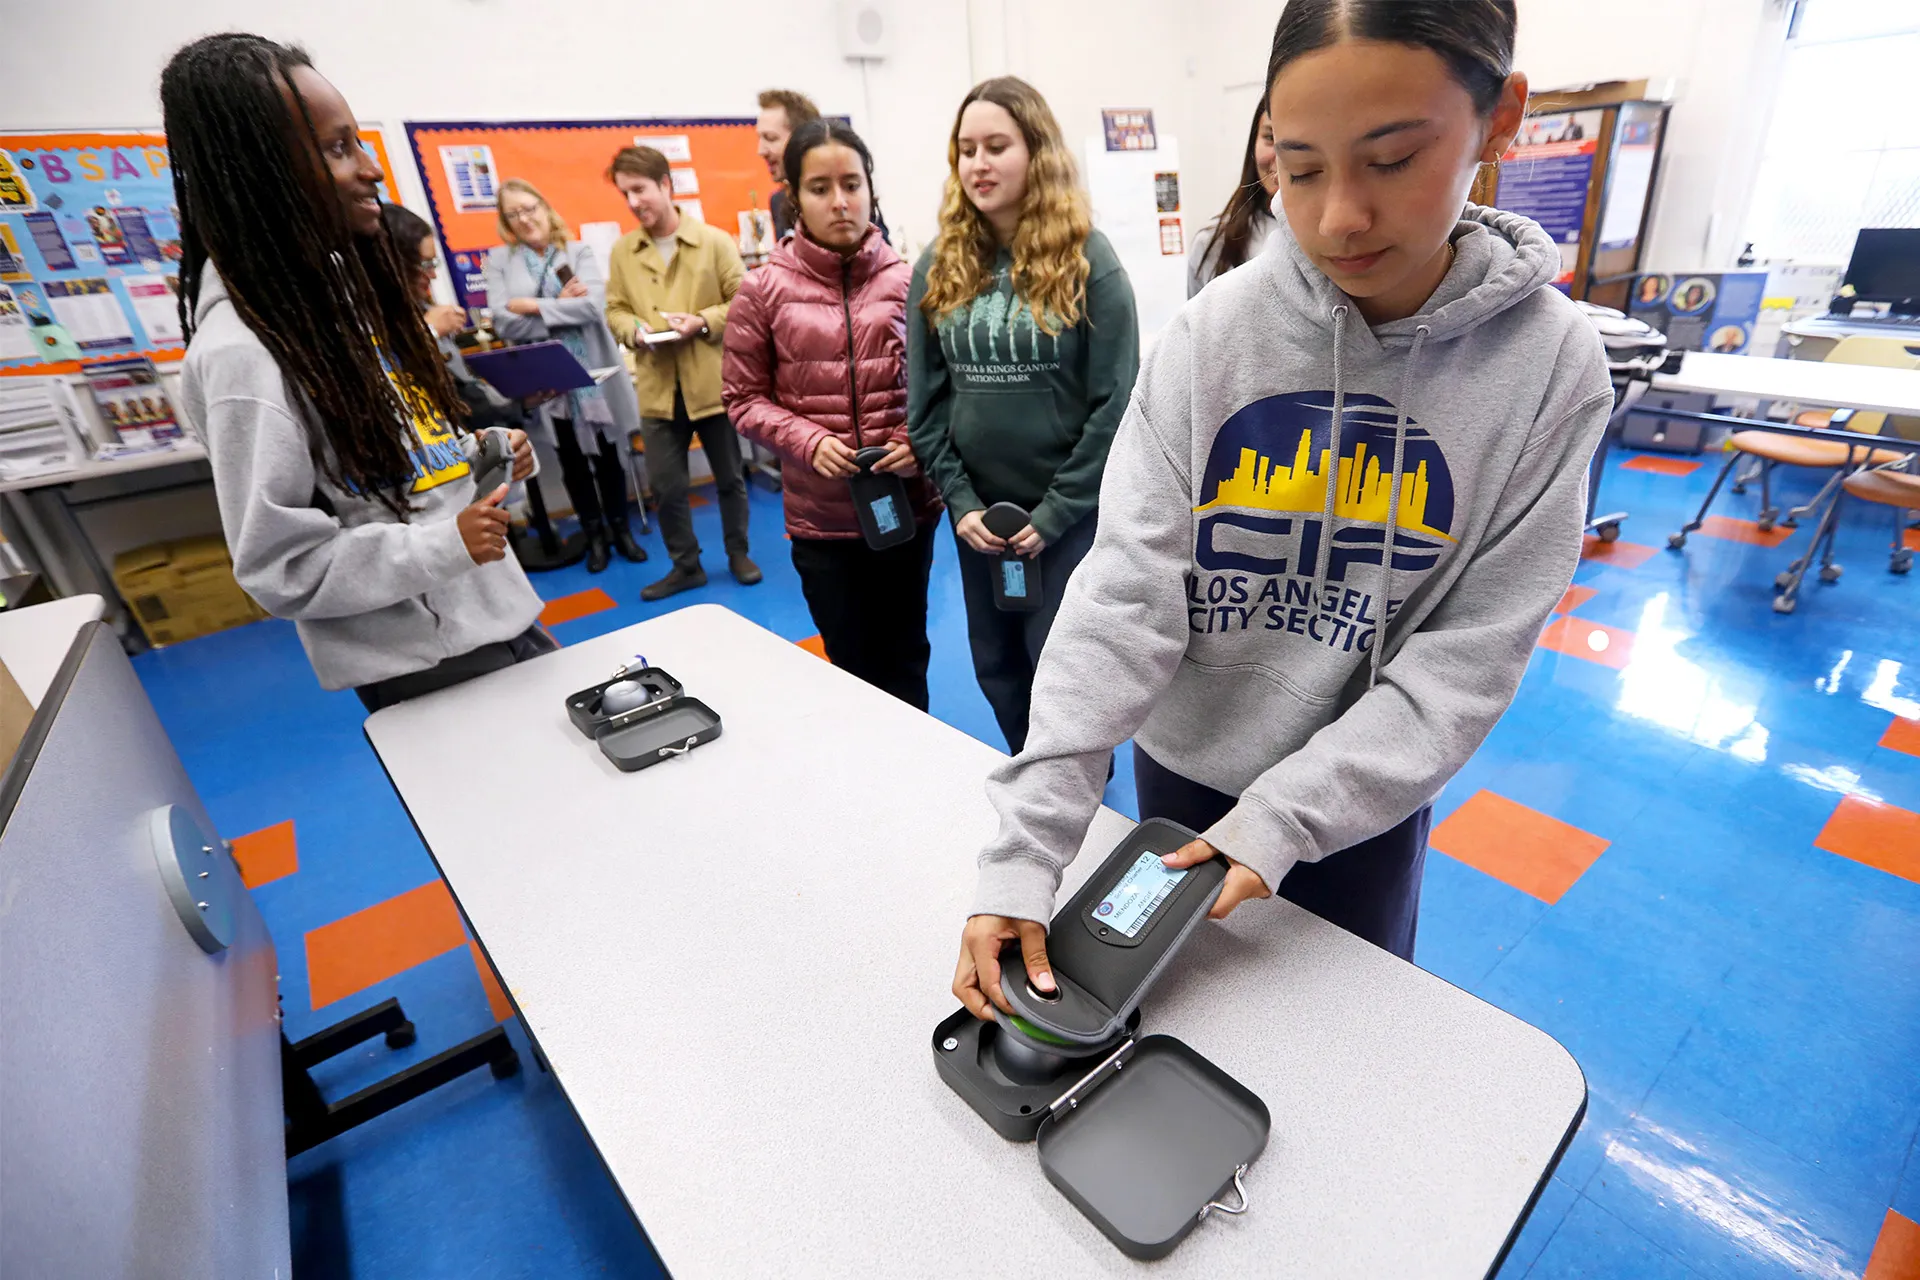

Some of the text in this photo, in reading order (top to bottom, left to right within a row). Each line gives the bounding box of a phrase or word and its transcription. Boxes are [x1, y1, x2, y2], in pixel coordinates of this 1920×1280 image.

[986, 364, 1017, 374] KINGS
[1018, 362, 1060, 372] CANYON
[965, 373, 1031, 383] NATIONAL PARK
[1189, 576, 1249, 604] LOS
[1188, 605, 1258, 634] CITY
[1140, 855, 1151, 864] 12
[1113, 892, 1140, 919] MENDOZA
